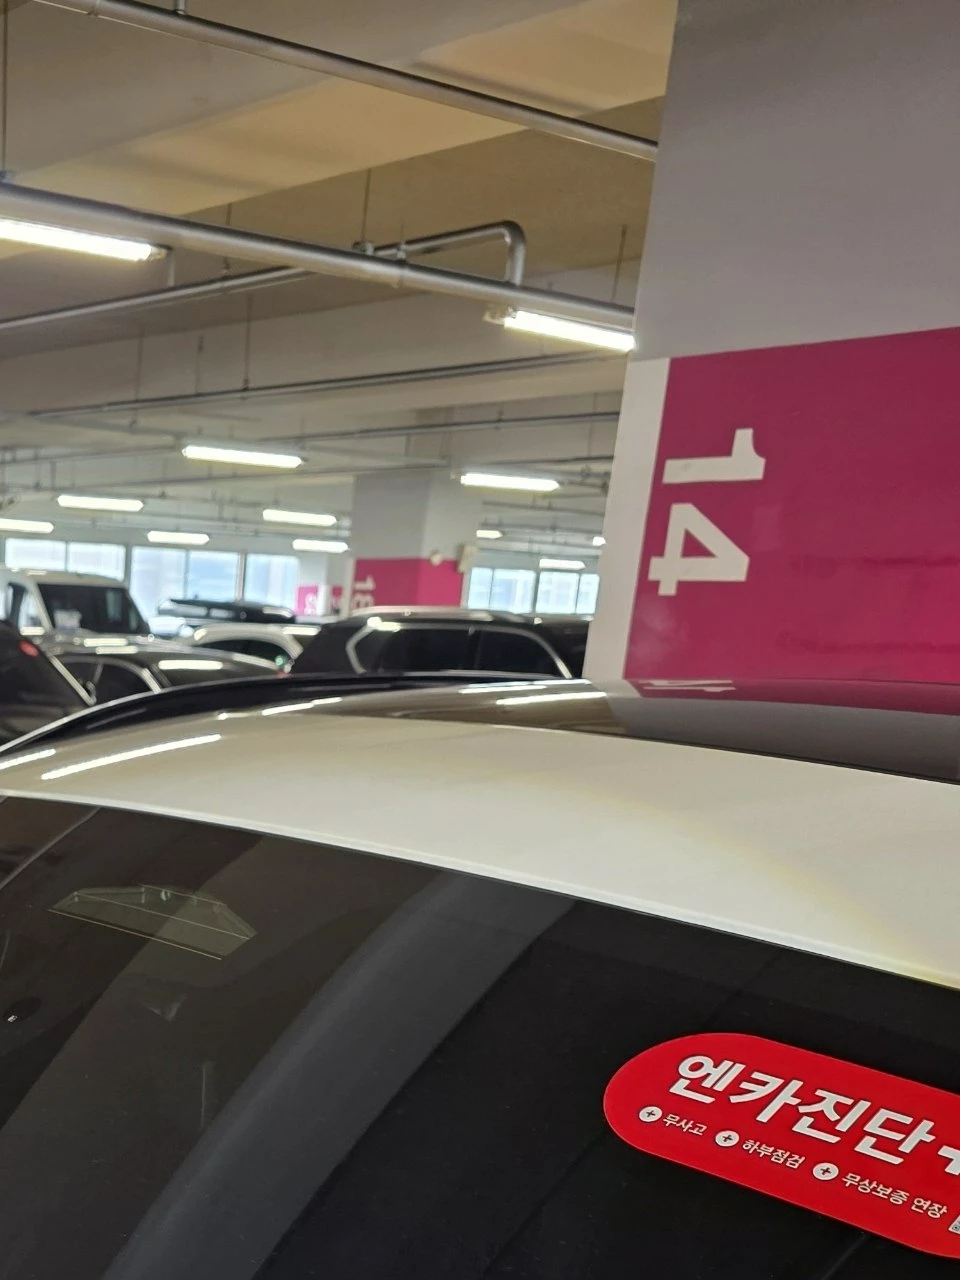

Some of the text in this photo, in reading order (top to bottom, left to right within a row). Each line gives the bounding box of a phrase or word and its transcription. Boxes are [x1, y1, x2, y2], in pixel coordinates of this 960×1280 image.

[648, 427, 766, 596] 14
[662, 1113, 948, 1219] 무사고 하부점검 무상보증 연장
